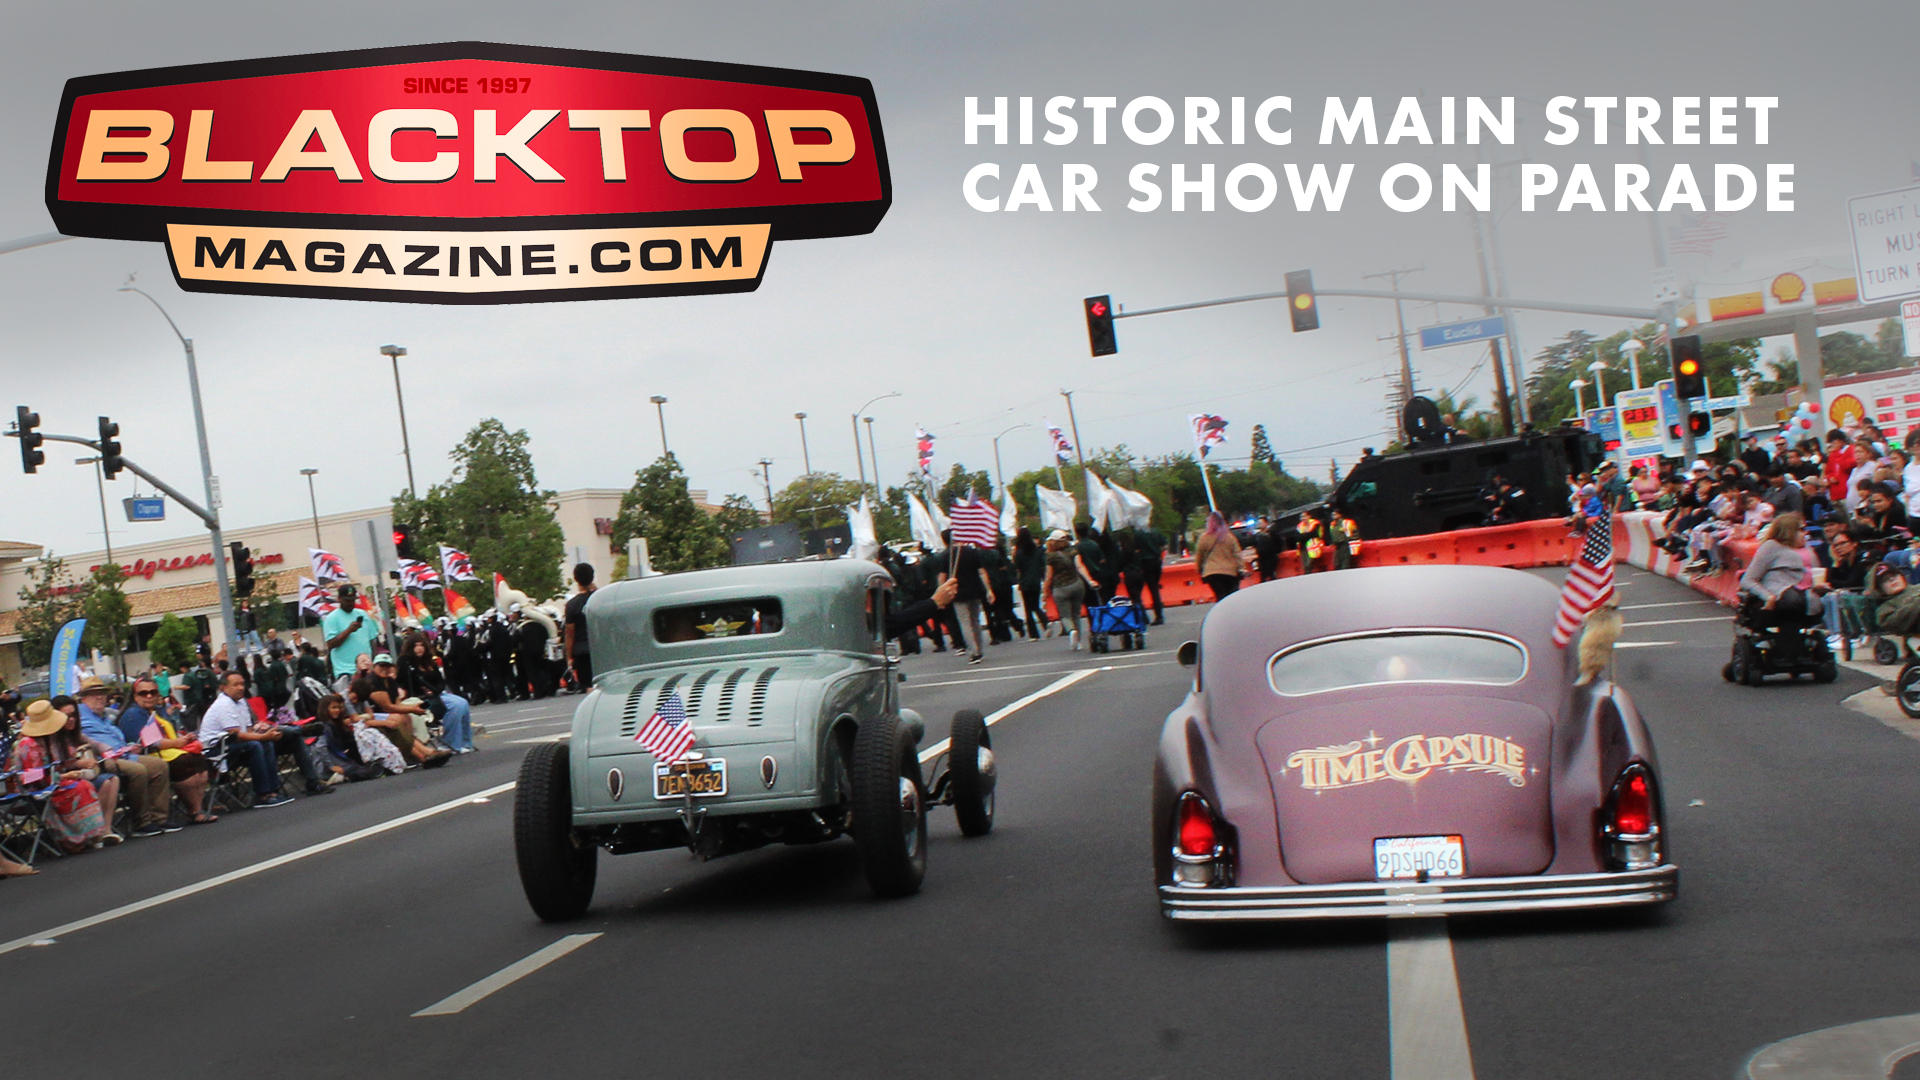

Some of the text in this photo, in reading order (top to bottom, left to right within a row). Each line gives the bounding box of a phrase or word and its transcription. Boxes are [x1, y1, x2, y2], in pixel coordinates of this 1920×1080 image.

[1857, 205, 1905, 228] RIGHT
[1866, 264, 1910, 285] TURN
[1443, 325, 1484, 341] Euclid
[90, 552, 230, 581] algreen
[56, 627, 76, 696] MASSAG
[1287, 733, 1526, 790] TIME CAPSULE
[1391, 838, 1445, 850] California
